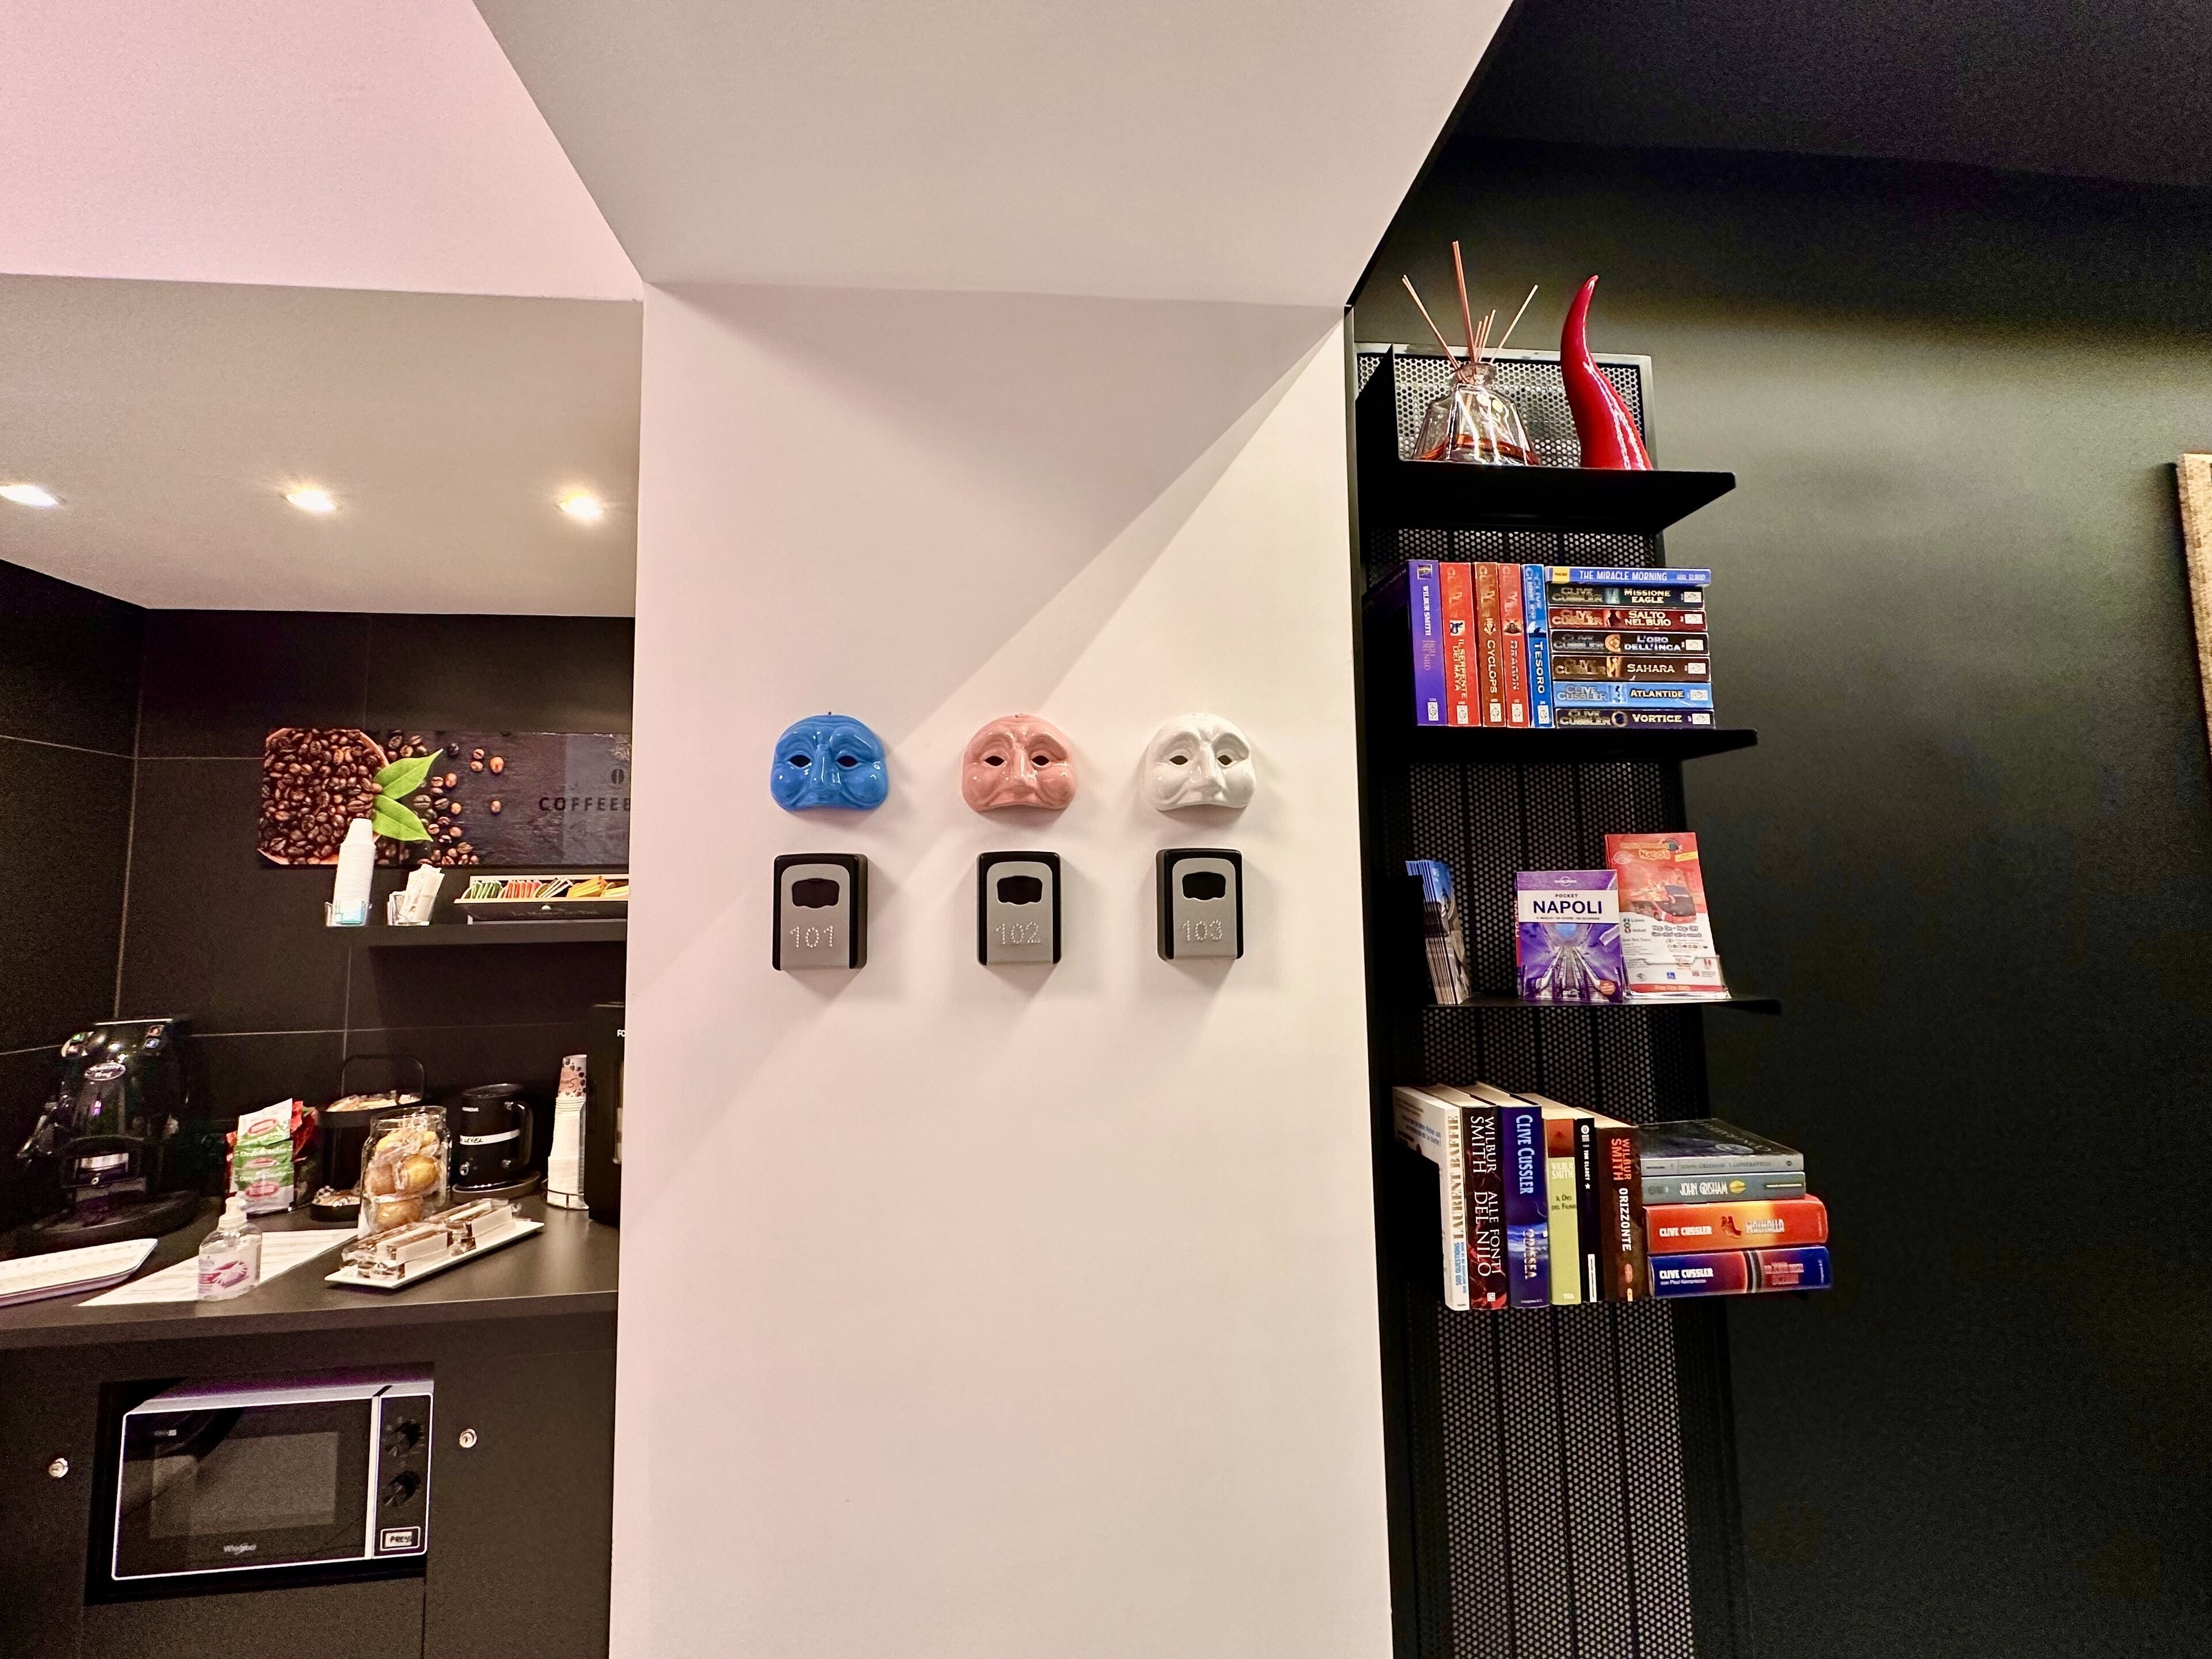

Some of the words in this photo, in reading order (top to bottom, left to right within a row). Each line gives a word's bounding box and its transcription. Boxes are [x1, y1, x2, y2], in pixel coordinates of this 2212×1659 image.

[1580, 571, 1594, 579] THE
[1597, 571, 1629, 581] MIRACLE
[1632, 572, 1668, 581] MORNING
[1422, 585, 1430, 611] WILBUR
[1624, 589, 1671, 597] MISSIONE
[1628, 611, 1665, 619] SALTO
[1454, 662, 1462, 691] MAYA
[1459, 648, 1468, 699] SERPENTE
[1487, 640, 1498, 694] CYCLOPS
[1510, 640, 1520, 690] DRAGON
[1534, 641, 1545, 694] TESORO
[1627, 664, 1675, 673] SAHARA
[1557, 692, 1607, 701] CUSSLER
[1566, 685, 1597, 694] CLIVE
[1630, 689, 1684, 698] ATLANTIDE
[1559, 715, 1611, 726] CUSSLER
[1632, 713, 1682, 723] VORTICE
[1533, 900, 1603, 914] NAPOLI
[790, 925, 833, 948] 101
[995, 922, 1040, 944] 102
[1181, 919, 1222, 941] 103
[1448, 1116, 1461, 1168] BAFFIE
[1516, 1114, 1533, 1145] CLIVE
[1471, 1116, 1487, 1173] SMITH
[1484, 1116, 1497, 1173] WILBUR
[1518, 1147, 1535, 1195] CUSSLER
[1551, 1161, 1574, 1169] WILBUR
[1611, 1138, 1624, 1180] SMITH
[1622, 1138, 1632, 1180] WILBUR
[1552, 1170, 1574, 1180] SMITH
[1679, 1183, 1698, 1196] JOHN
[1699, 1181, 1728, 1195] GRISHAM
[1450, 1172, 1464, 1239] LAURENT
[1474, 1191, 1488, 1224] DEL
[1488, 1191, 1499, 1223] ALLE
[1619, 1188, 1632, 1252] ORIZZONTE
[1659, 1227, 1679, 1237] CLIVE
[1680, 1226, 1713, 1236] CUSSLER
[1476, 1231, 1491, 1277] NILO
[1490, 1229, 1502, 1274] FONTI
[1659, 1269, 1680, 1279] CLIVE
[1681, 1267, 1714, 1278] CUSSLER
